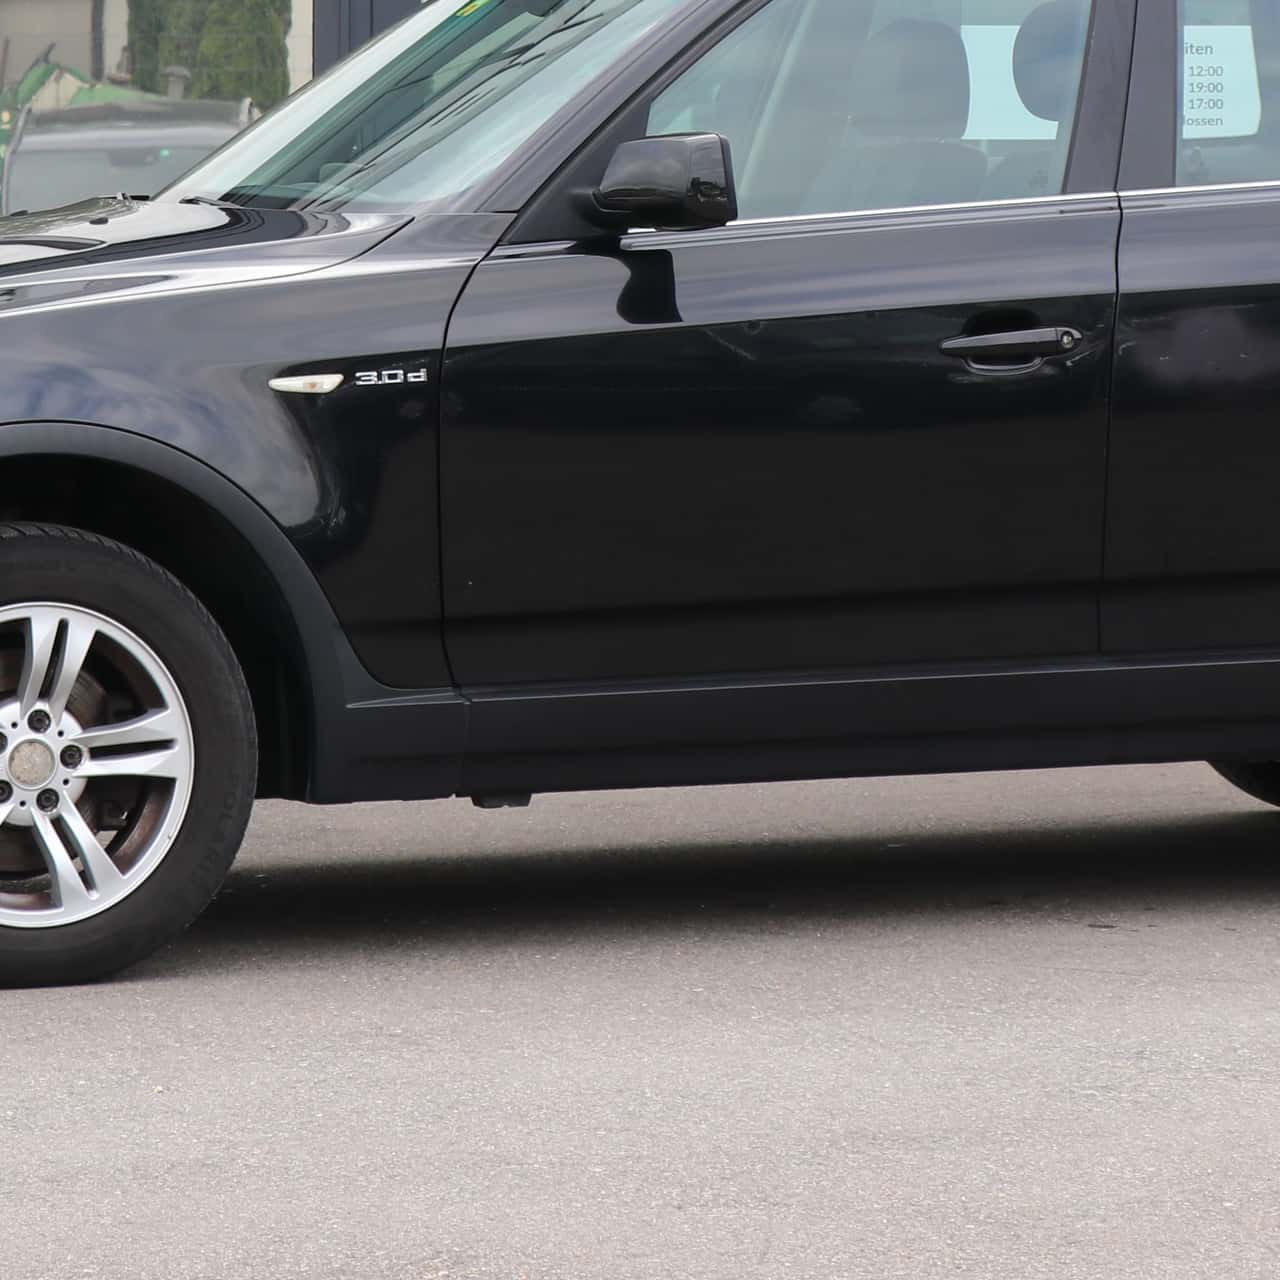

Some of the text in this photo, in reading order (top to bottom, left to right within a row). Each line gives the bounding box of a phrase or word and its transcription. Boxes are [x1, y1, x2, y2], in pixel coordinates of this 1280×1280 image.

[1188, 65, 1224, 78] 12:00
[1188, 82, 1224, 94] 19:00
[1188, 98, 1224, 110] 17:00
